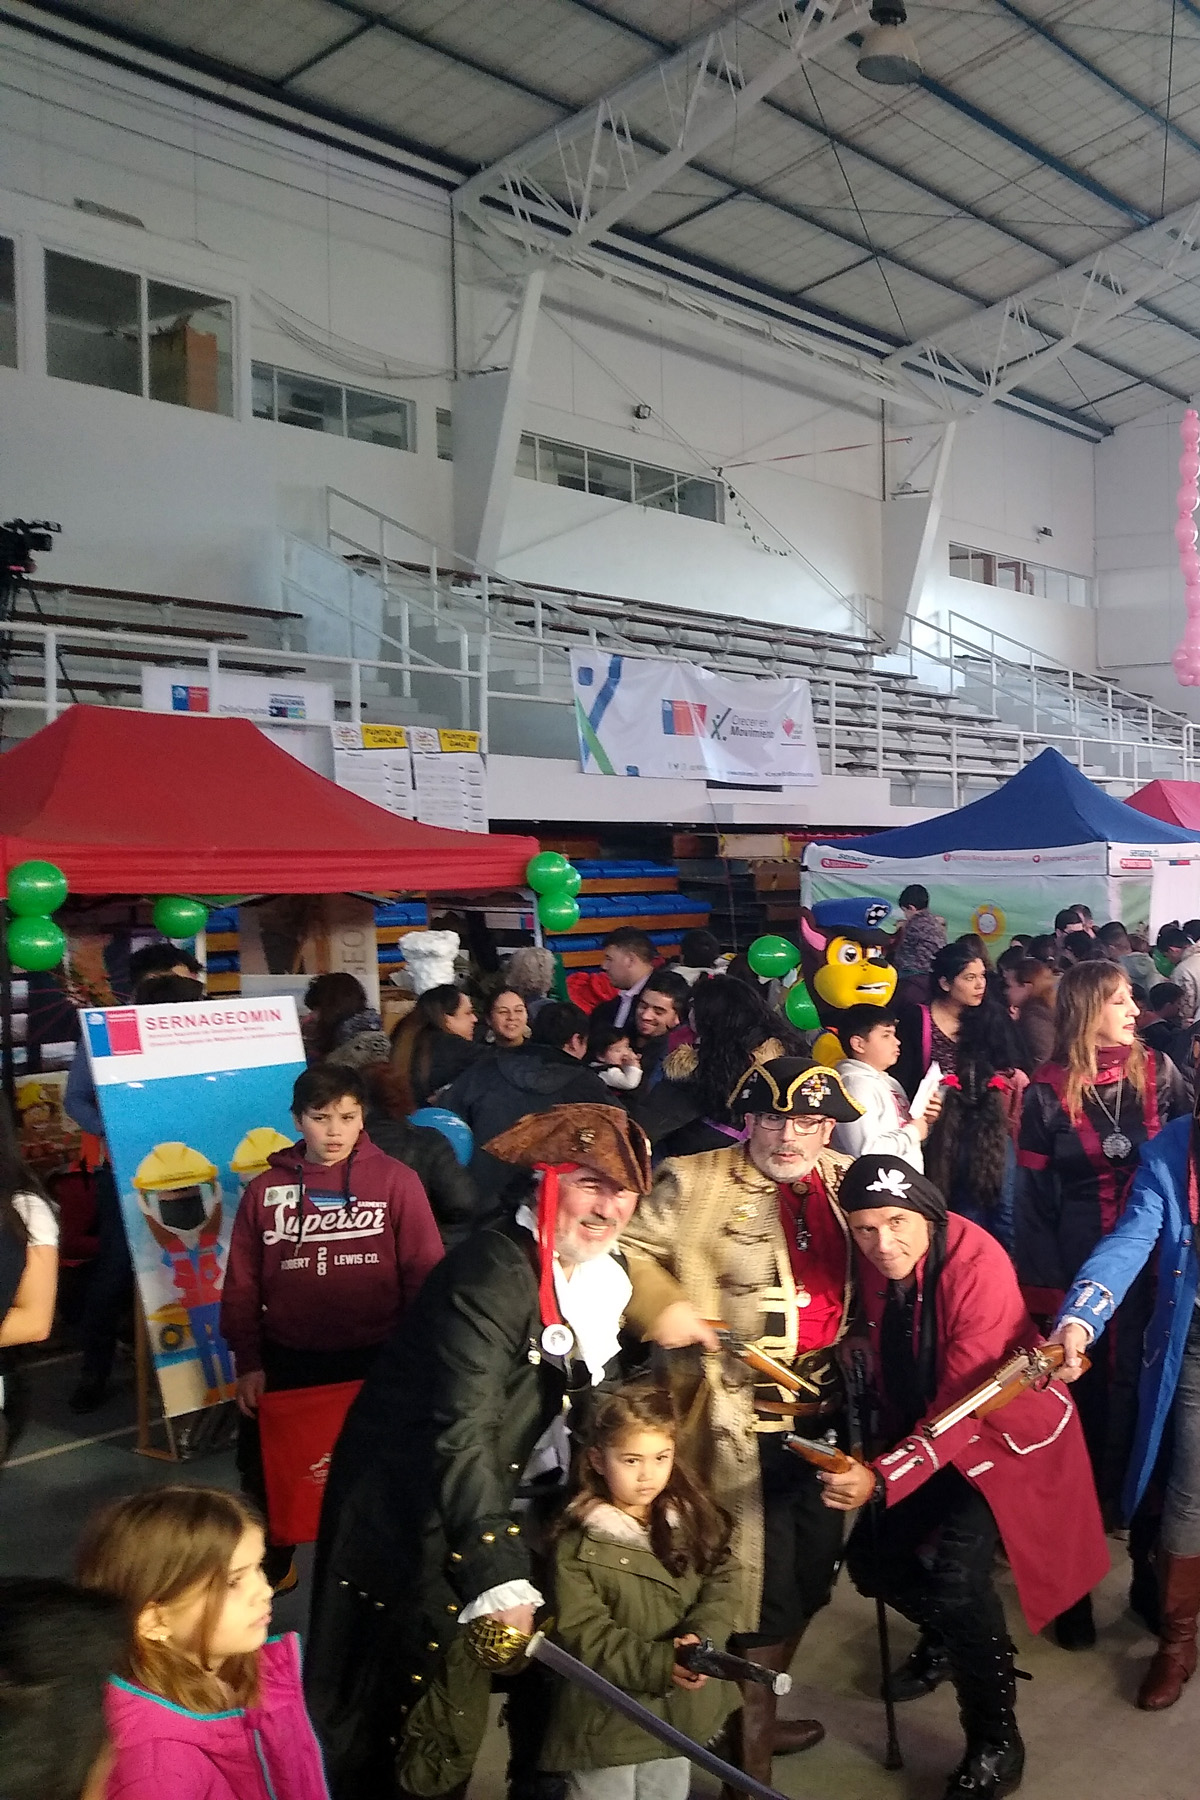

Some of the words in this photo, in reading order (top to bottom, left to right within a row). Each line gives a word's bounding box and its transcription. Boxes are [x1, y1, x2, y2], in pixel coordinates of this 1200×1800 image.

[145, 1008, 283, 1031] SERNAGEOMIN
[263, 1201, 385, 1245] Superior
[333, 1253, 364, 1266] LEWIS
